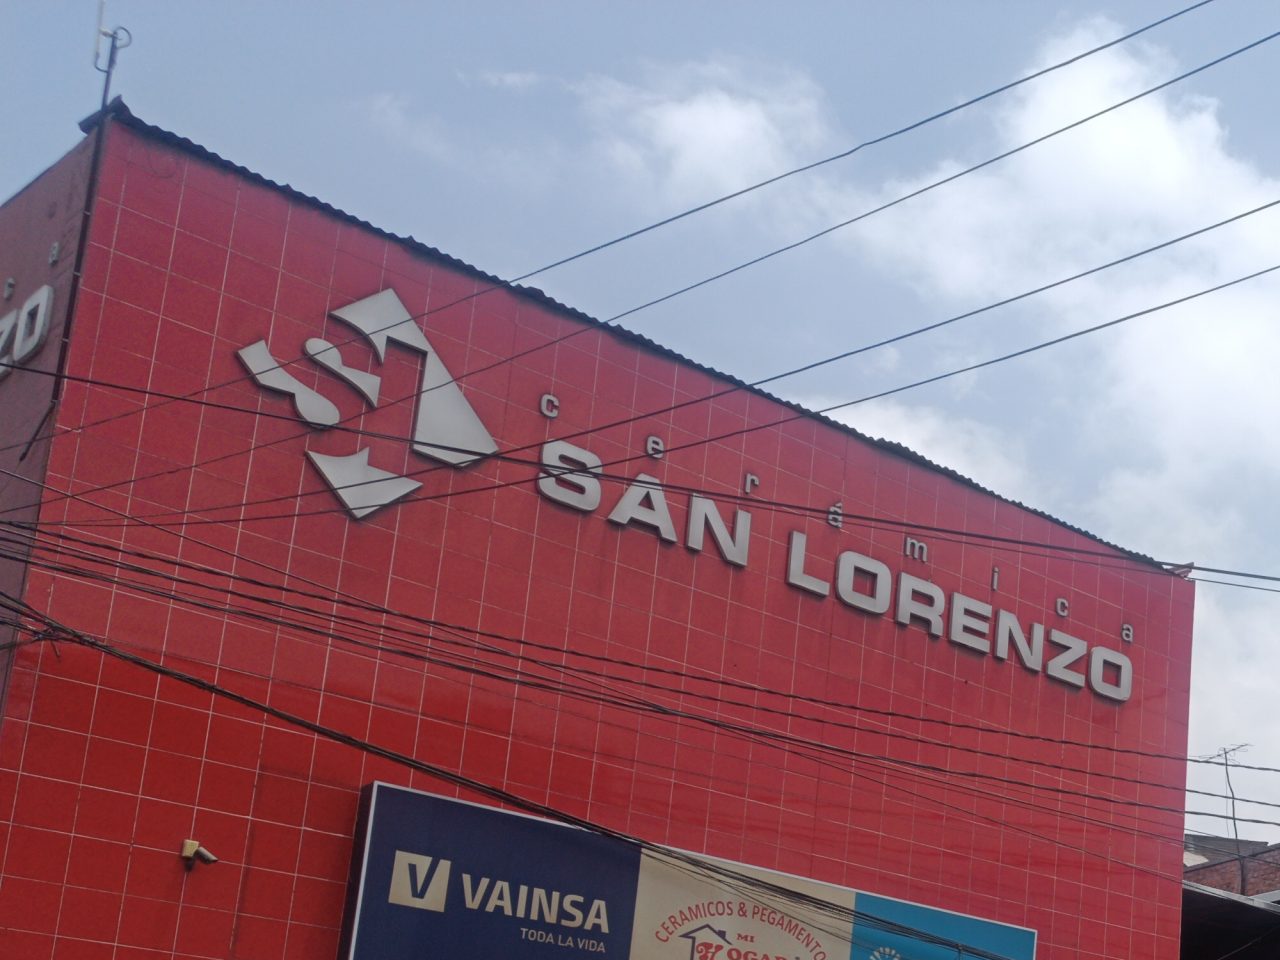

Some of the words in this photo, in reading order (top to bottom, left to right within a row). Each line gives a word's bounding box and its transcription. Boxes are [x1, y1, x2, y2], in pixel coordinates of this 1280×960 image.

[535, 439, 752, 568] SAN
[786, 530, 1133, 702] LORENZO
[462, 873, 610, 934] VAINSA
[655, 901, 733, 943] CERAMICOS
[738, 902, 748, 917] &
[520, 928, 554, 944] TODA
[558, 935, 574, 948] LA
[577, 938, 606, 953] VIDA
[736, 933, 754, 943] MI
